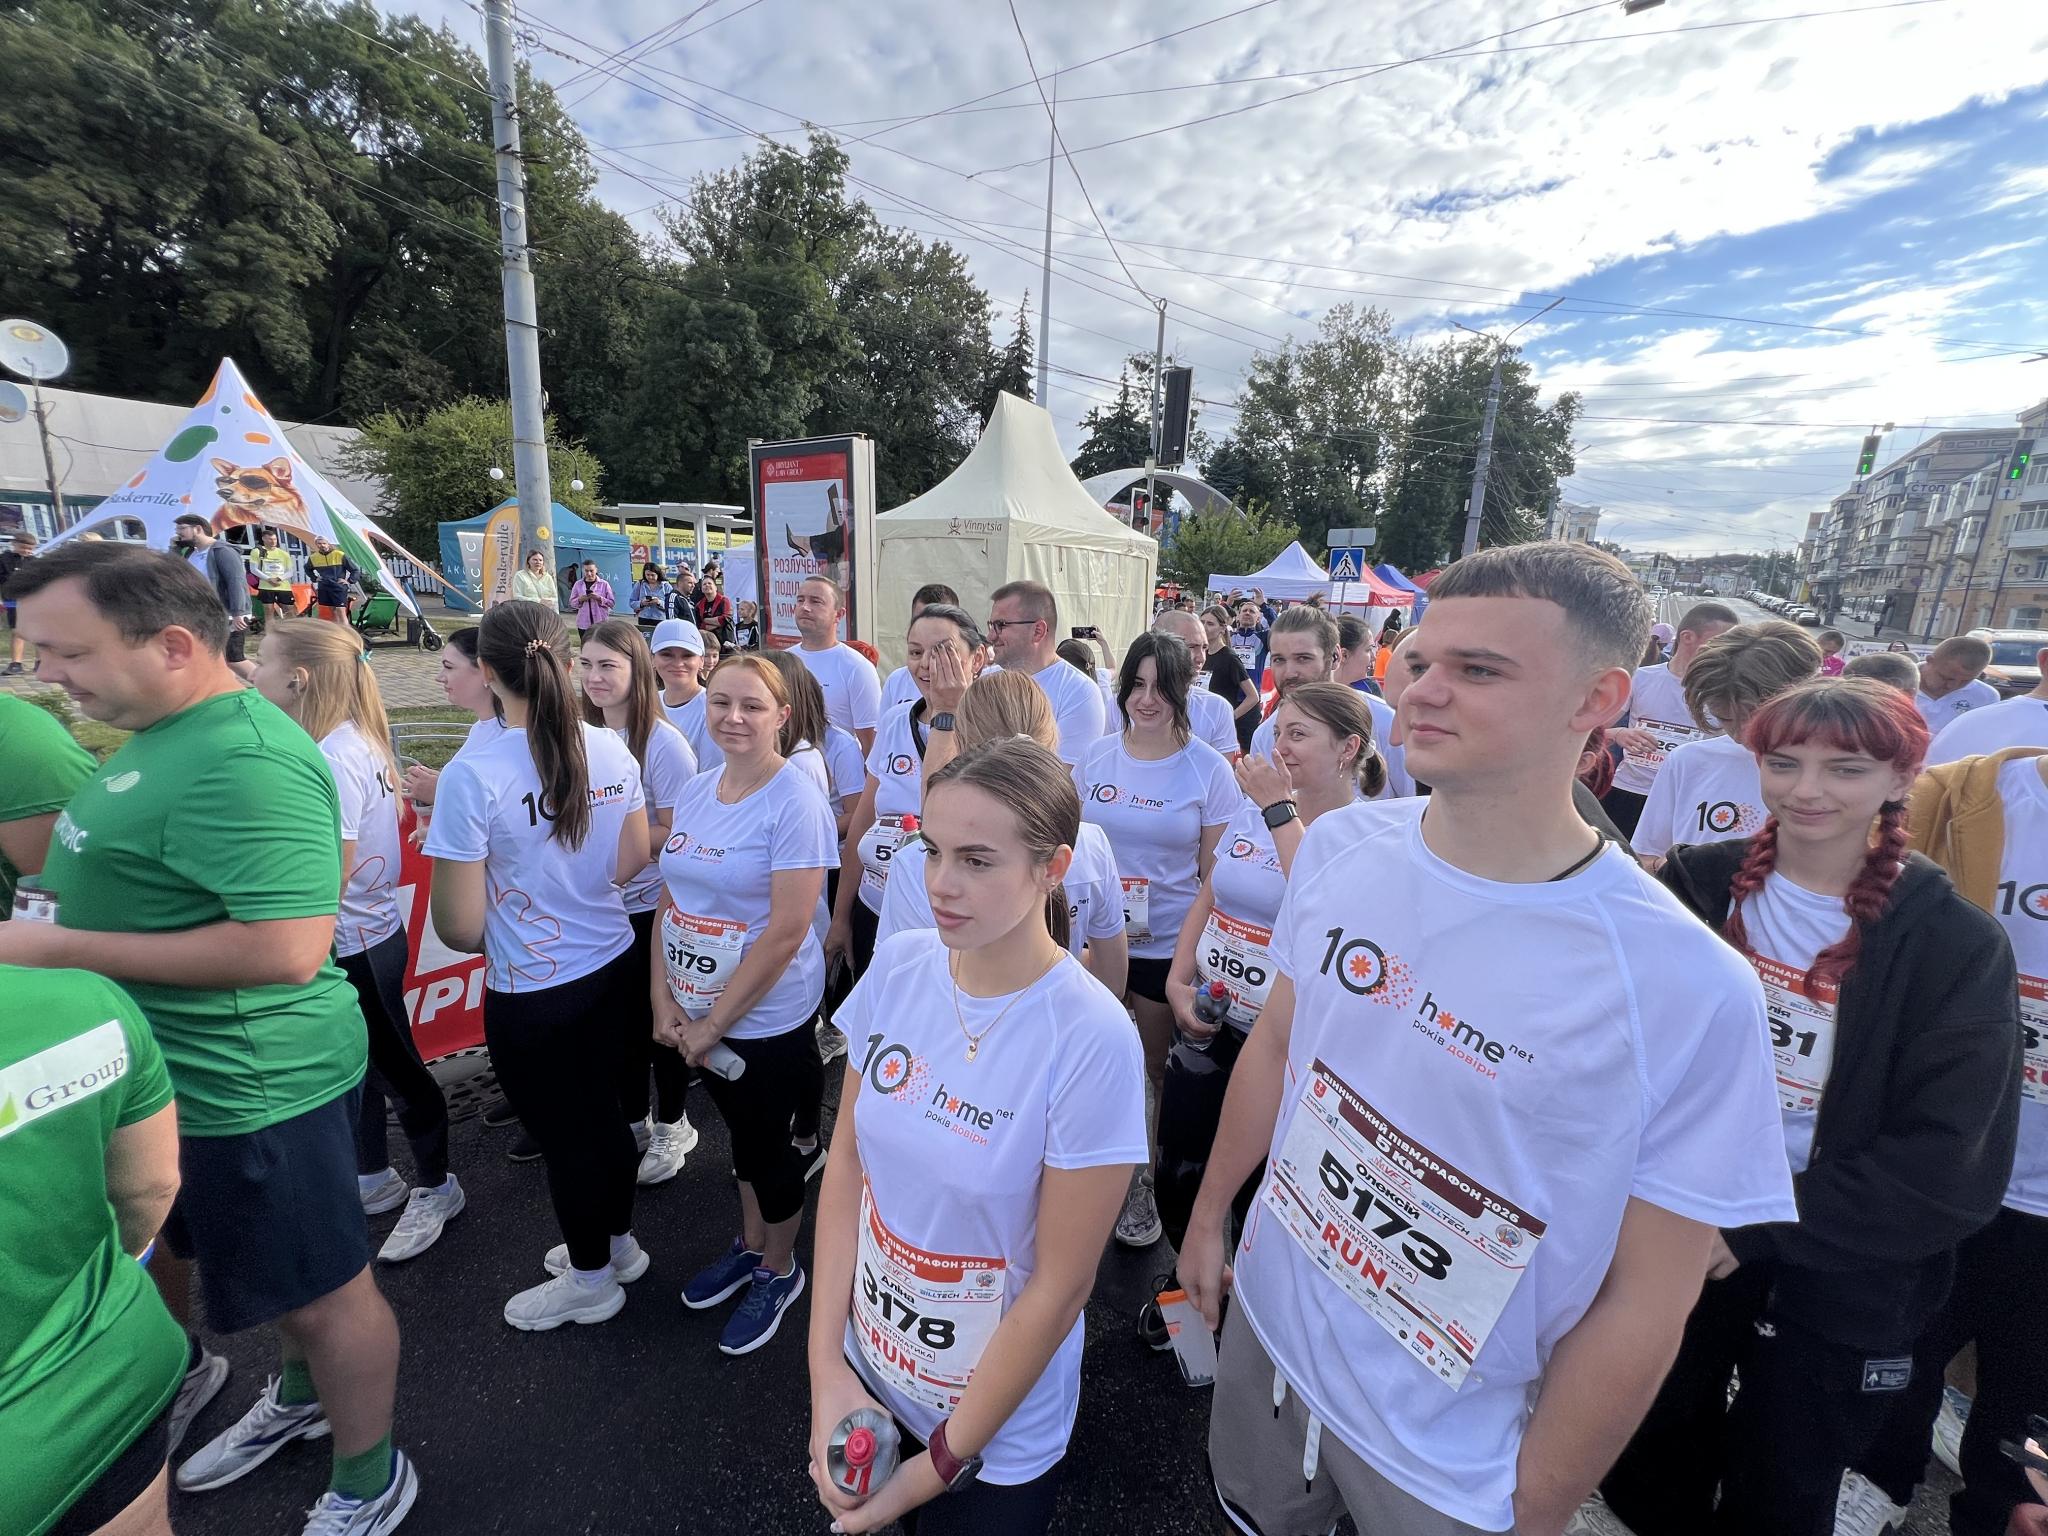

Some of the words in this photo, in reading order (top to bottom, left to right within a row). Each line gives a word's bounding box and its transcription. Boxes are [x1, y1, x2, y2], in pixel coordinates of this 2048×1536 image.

[1911, 483, 1946, 493] СТОП
[963, 518, 1002, 532] Vinnytsia
[496, 524, 509, 594] Baskerville
[886, 752, 913, 776] 10
[1090, 782, 1118, 803] 10
[1696, 800, 1740, 833] 10
[667, 942, 717, 975] 3179
[1208, 948, 1267, 987] 3190
[1320, 926, 1388, 996] 10
[862, 1032, 913, 1095] 10
[1412, 1019, 1446, 1046] років
[1446, 1043, 1498, 1081] довіри
[1508, 1043, 1536, 1064] net
[25, 1056, 124, 1110] Group
[924, 1109, 951, 1128] років
[951, 1123, 989, 1146] довіри
[996, 1108, 1015, 1121] net
[1322, 1071, 1388, 1135] ВІННИЦЬКИЙ
[1388, 1132, 1482, 1201] ПІВМАРАФОН
[1482, 1196, 1520, 1223] 2026
[1375, 1133, 1393, 1153] 5
[1392, 1150, 1425, 1180] КМ
[1355, 1163, 1421, 1221] Олексій
[1318, 1148, 1453, 1281] 5173
[1421, 1199, 1470, 1236] BILLTECH
[881, 1240, 892, 1256] 3
[893, 1252, 916, 1273] КМ
[887, 1236, 959, 1269] ПІВМАРАФОН
[960, 1260, 988, 1269] 2026
[1320, 1192, 1414, 1280] ПРОМАВТОМАТИКА
[1321, 1220, 1388, 1291] RUN
[1338, 1219, 1383, 1265] VINNYTSIA
[863, 1261, 956, 1350] 3178
[880, 1275, 915, 1304] Аліна
[871, 1325, 916, 1379] RUN
